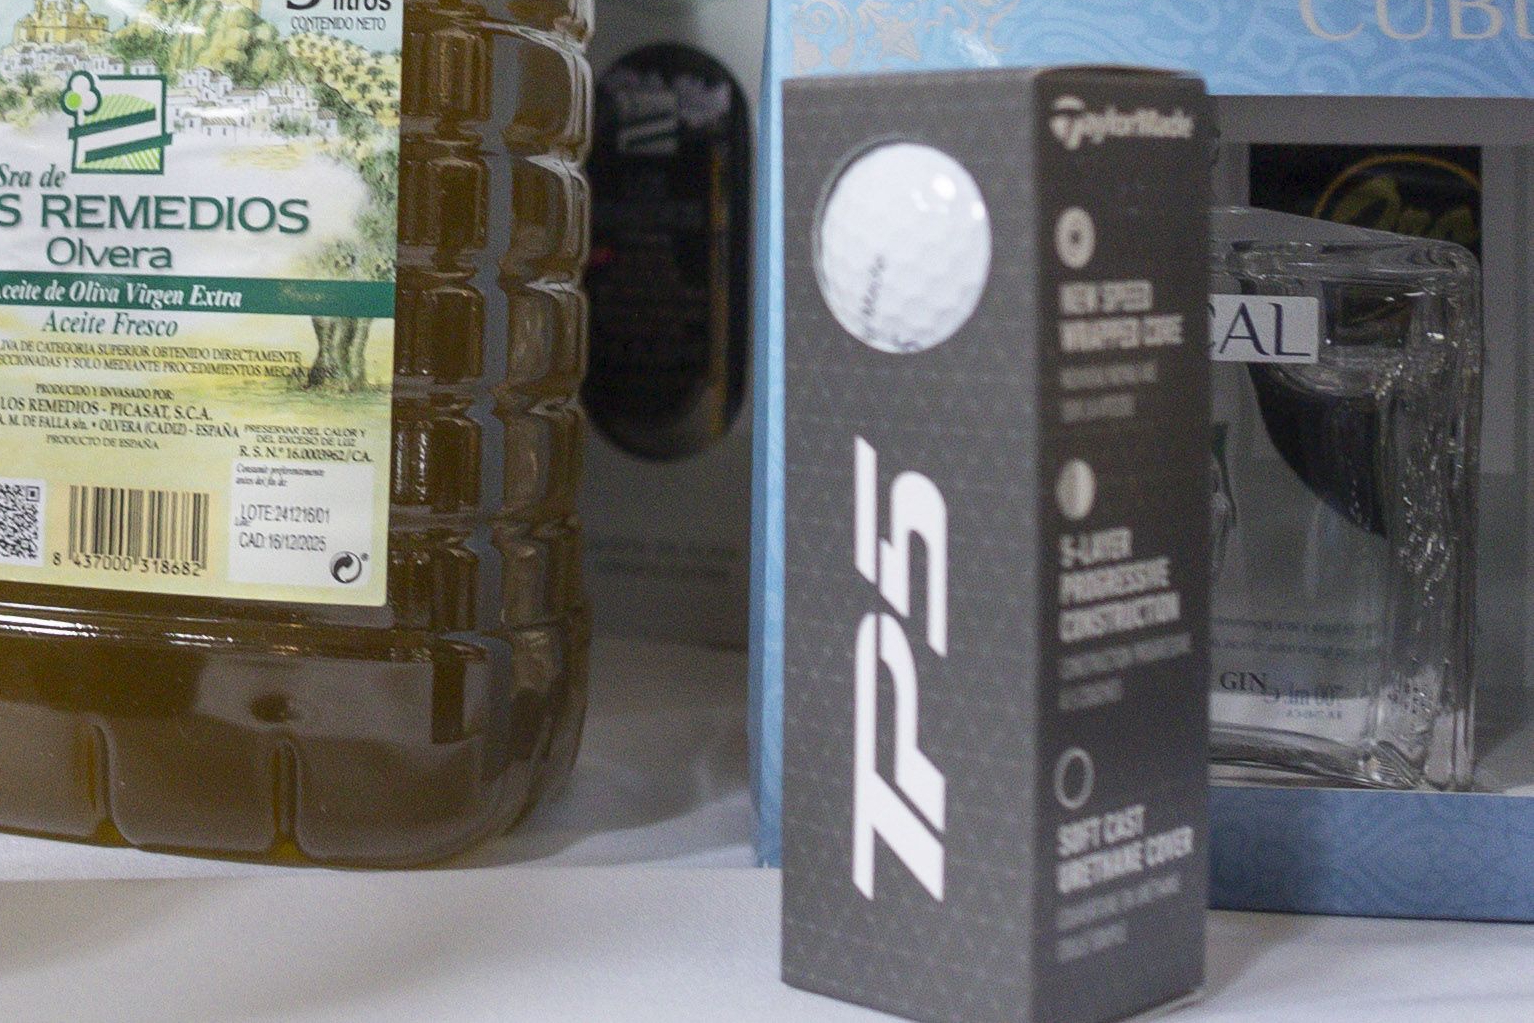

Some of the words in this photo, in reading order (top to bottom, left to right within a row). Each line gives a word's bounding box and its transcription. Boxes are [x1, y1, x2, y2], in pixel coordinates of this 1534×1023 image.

[291, 16, 354, 31] CONTENIDO
[356, 16, 387, 31] NETO
[39, 163, 66, 189] de
[40, 193, 311, 235] REMEDIOS
[46, 236, 174, 270] Olvera
[43, 280, 66, 302] de
[69, 279, 120, 304] Oliva
[125, 282, 186, 310] Virgen
[189, 284, 243, 308] Extra
[42, 309, 106, 335] Aceite
[112, 311, 178, 337] Fresco
[1207, 301, 1312, 357] AL
[20, 341, 35, 352] DE
[98, 344, 152, 358] SUPERIOR
[153, 345, 211, 360] OBTENIDO
[213, 348, 303, 364] DIRECTAMENTE
[74, 357, 102, 370] SOLO
[104, 358, 161, 373] MEDIANTE
[163, 360, 262, 378] PROCEDIMIENTOS
[36, 383, 91, 396] PRODUCIDO
[99, 386, 151, 399] ENVASADO
[0, 396, 26, 412] LOS
[28, 398, 99, 416] REMEDIOS
[174, 405, 213, 422] S.C.A.
[22, 415, 36, 427] DE
[38, 415, 70, 429] FALLA
[99, 420, 143, 434] OLVERA
[195, 422, 240, 438] ESPAÑA
[302, 426, 320, 436] DEL
[324, 427, 357, 438] CALOR
[45, 434, 101, 447] PRODUCTO
[103, 436, 116, 448] DE
[118, 437, 160, 450] ESPAÑA
[256, 434, 275, 444] DEL
[278, 435, 318, 445] EXCESO
[321, 437, 335, 447] DE
[52, 551, 62, 567] 8
[72, 553, 133, 572] 437000
[139, 558, 202, 577] 318682
[852, 434, 949, 902] TP5
[1219, 670, 1268, 694] GIN
